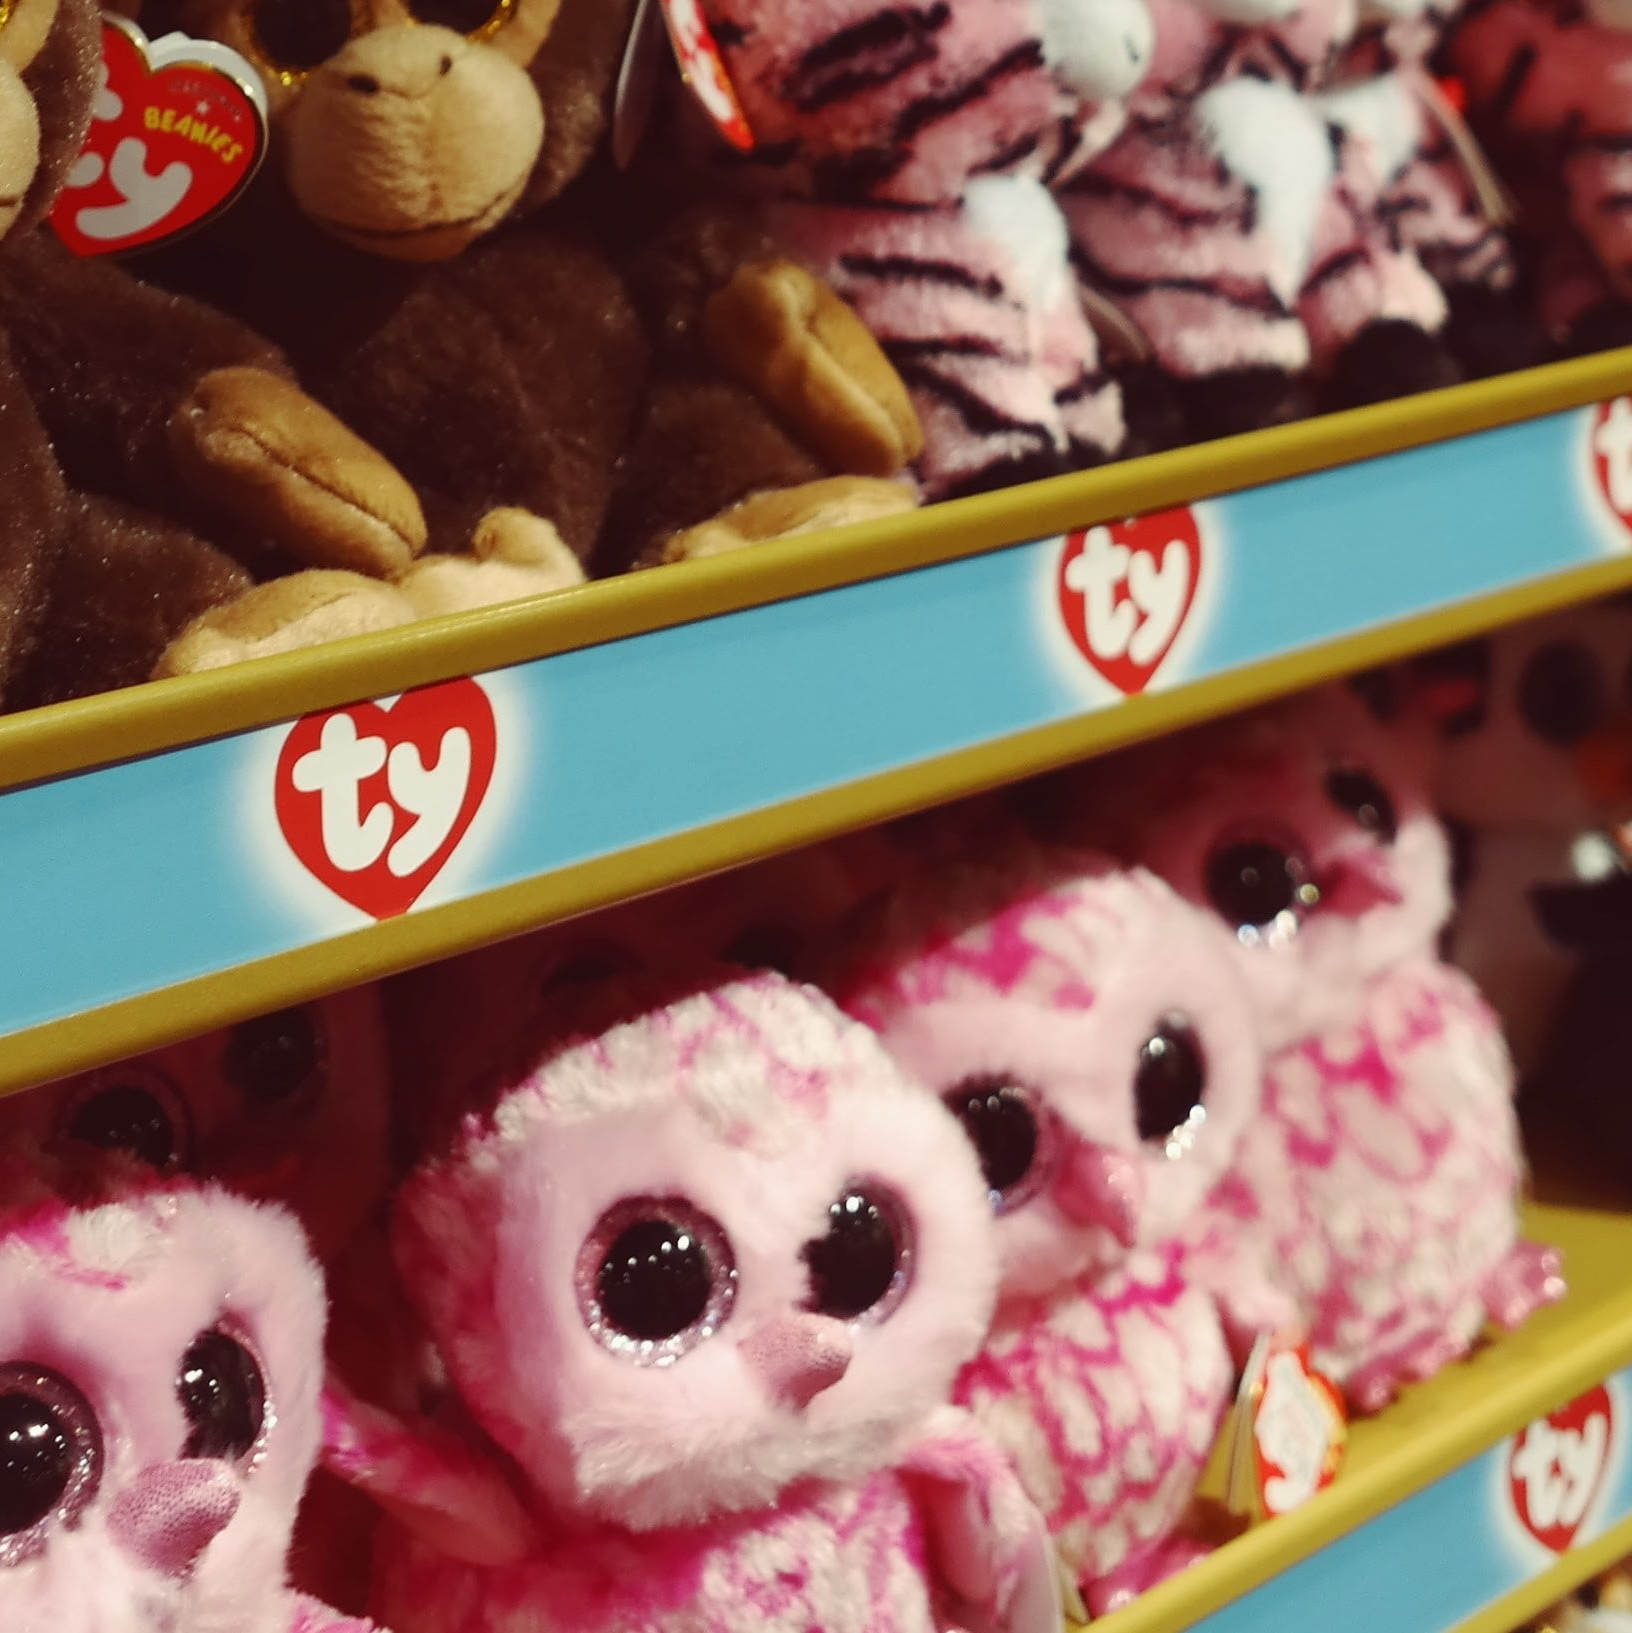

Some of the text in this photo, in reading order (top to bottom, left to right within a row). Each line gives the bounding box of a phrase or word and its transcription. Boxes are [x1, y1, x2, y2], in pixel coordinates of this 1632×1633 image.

[143, 106, 243, 163] BEANIES
[1065, 525, 1190, 666] ty
[290, 711, 472, 878] ty
[1513, 1412, 1607, 1528] ty
